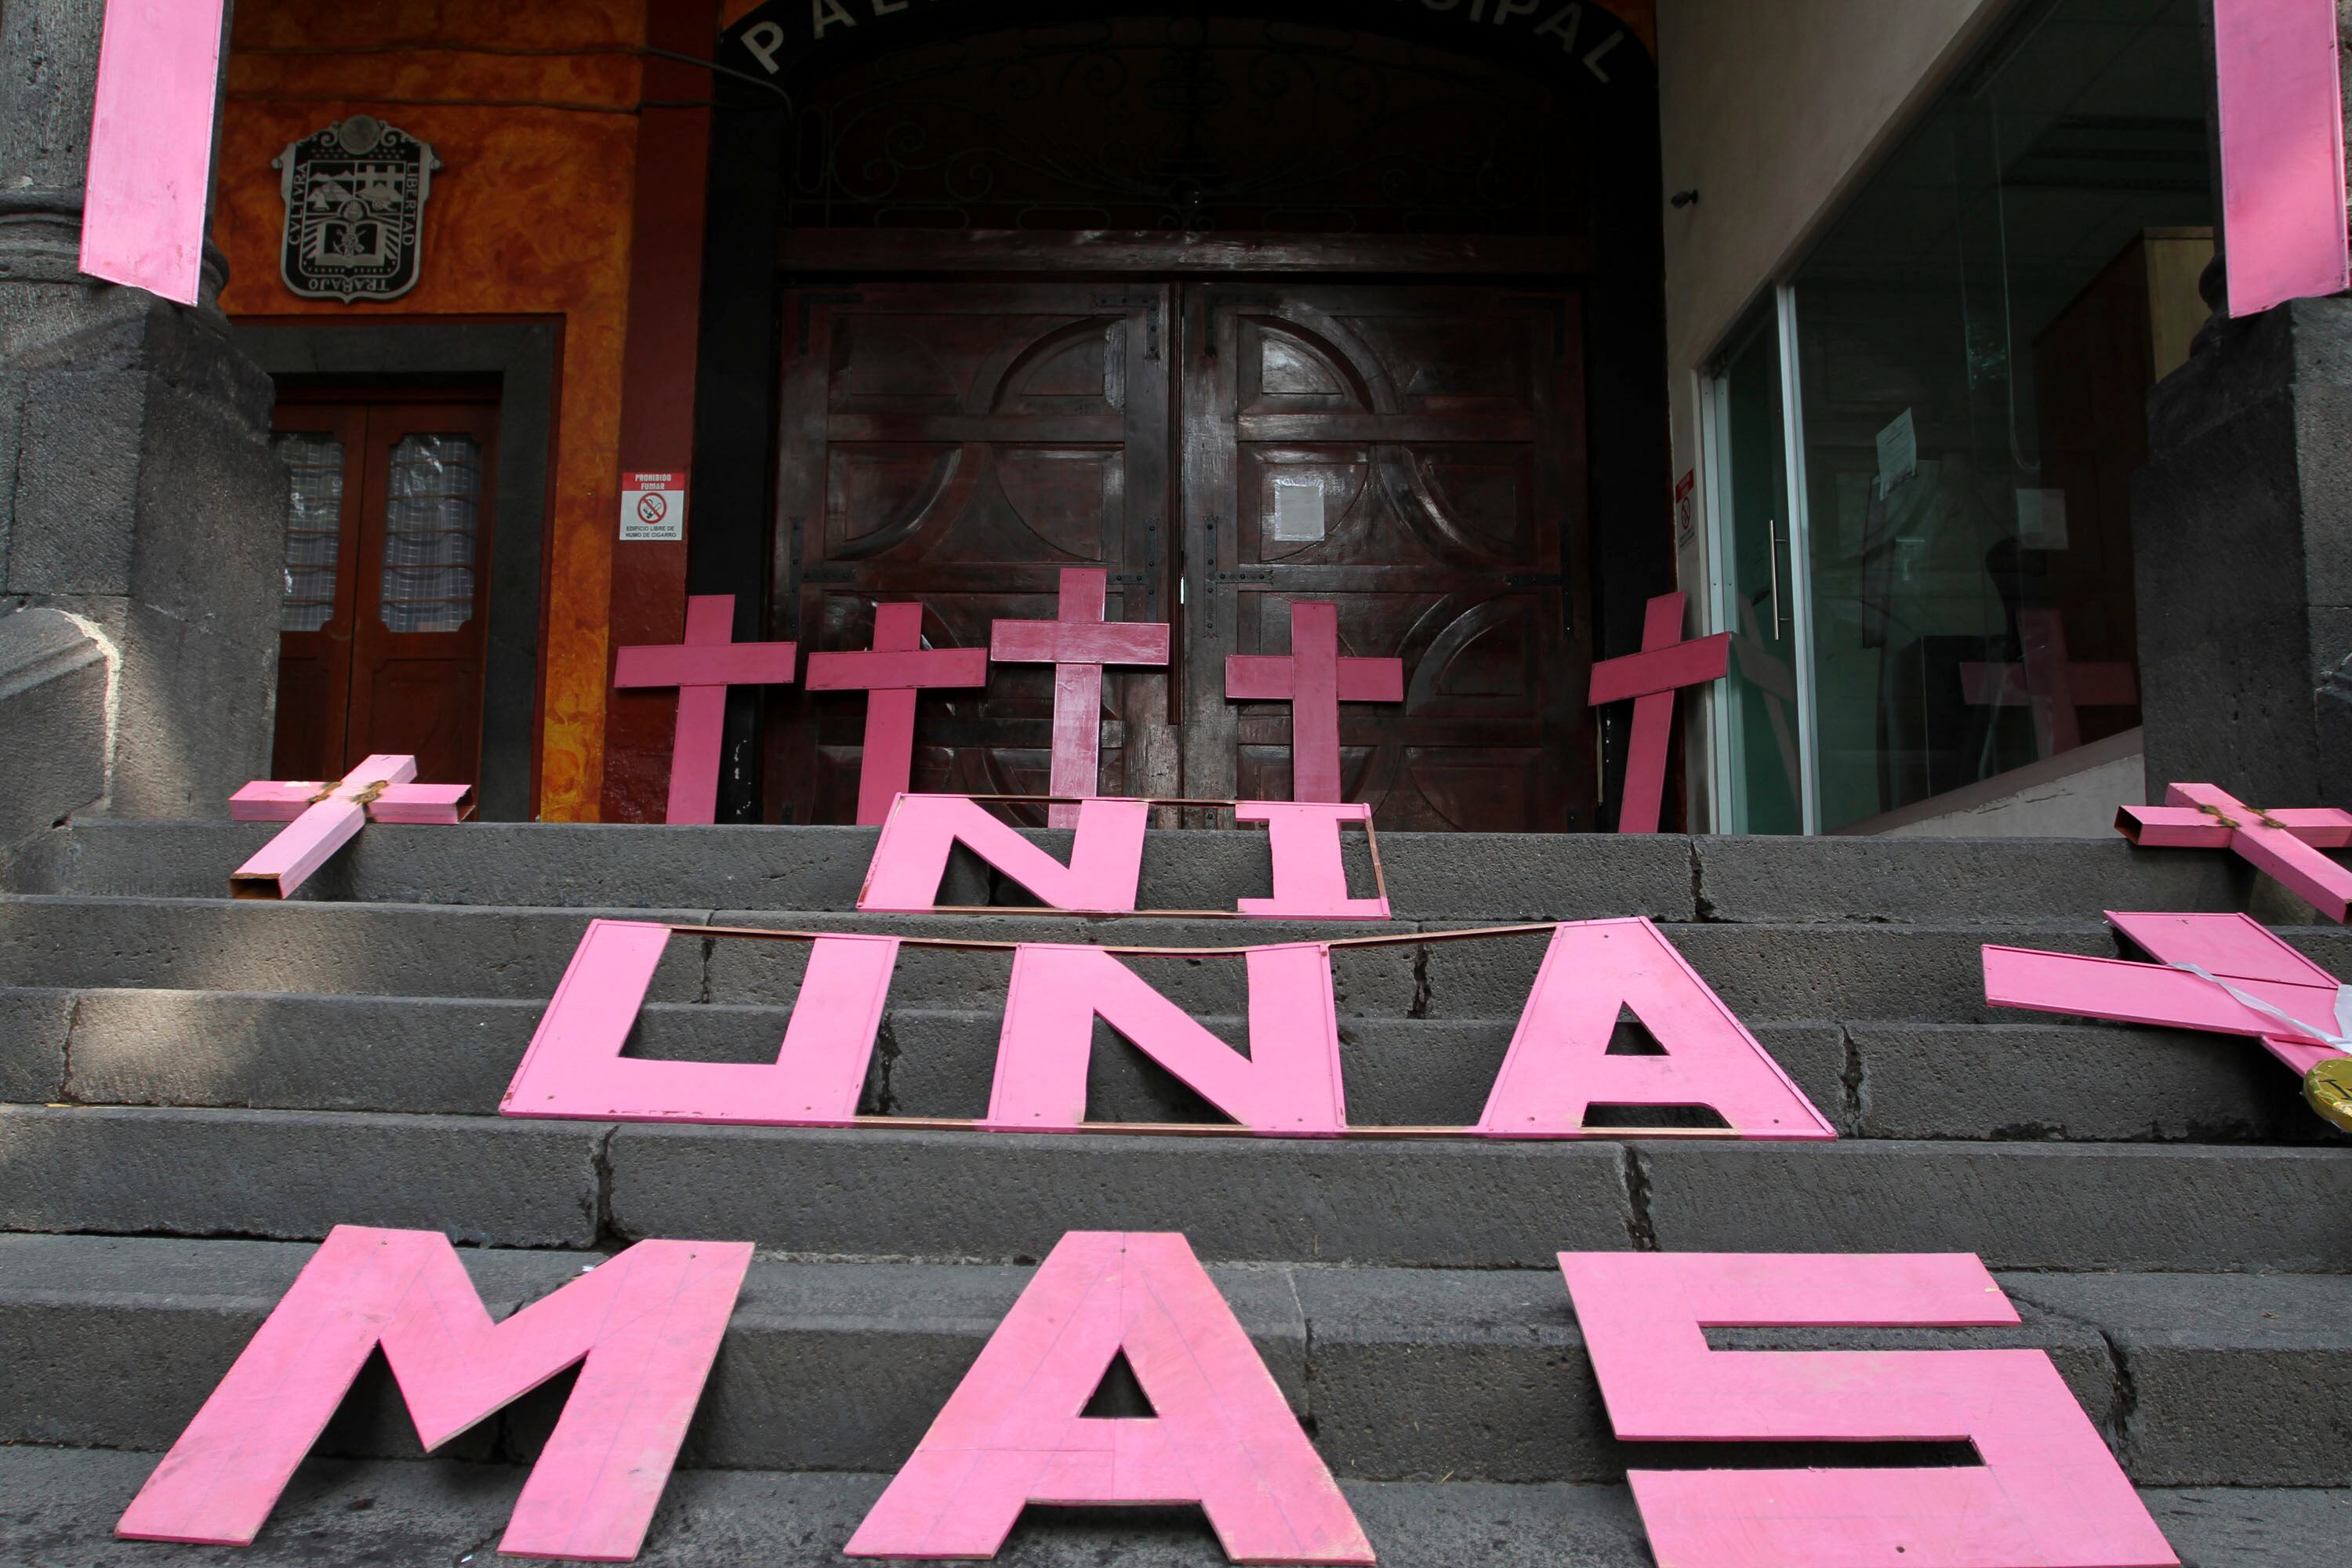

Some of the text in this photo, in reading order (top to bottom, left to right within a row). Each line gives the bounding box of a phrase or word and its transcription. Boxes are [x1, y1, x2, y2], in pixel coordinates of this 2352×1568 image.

[402, 162, 419, 245] LIBERTAD
[308, 278, 390, 293] TRABAJO
[856, 792, 1391, 920] NI
[499, 916, 1838, 1140] UNA
[116, 1223, 2180, 1568] MAS
